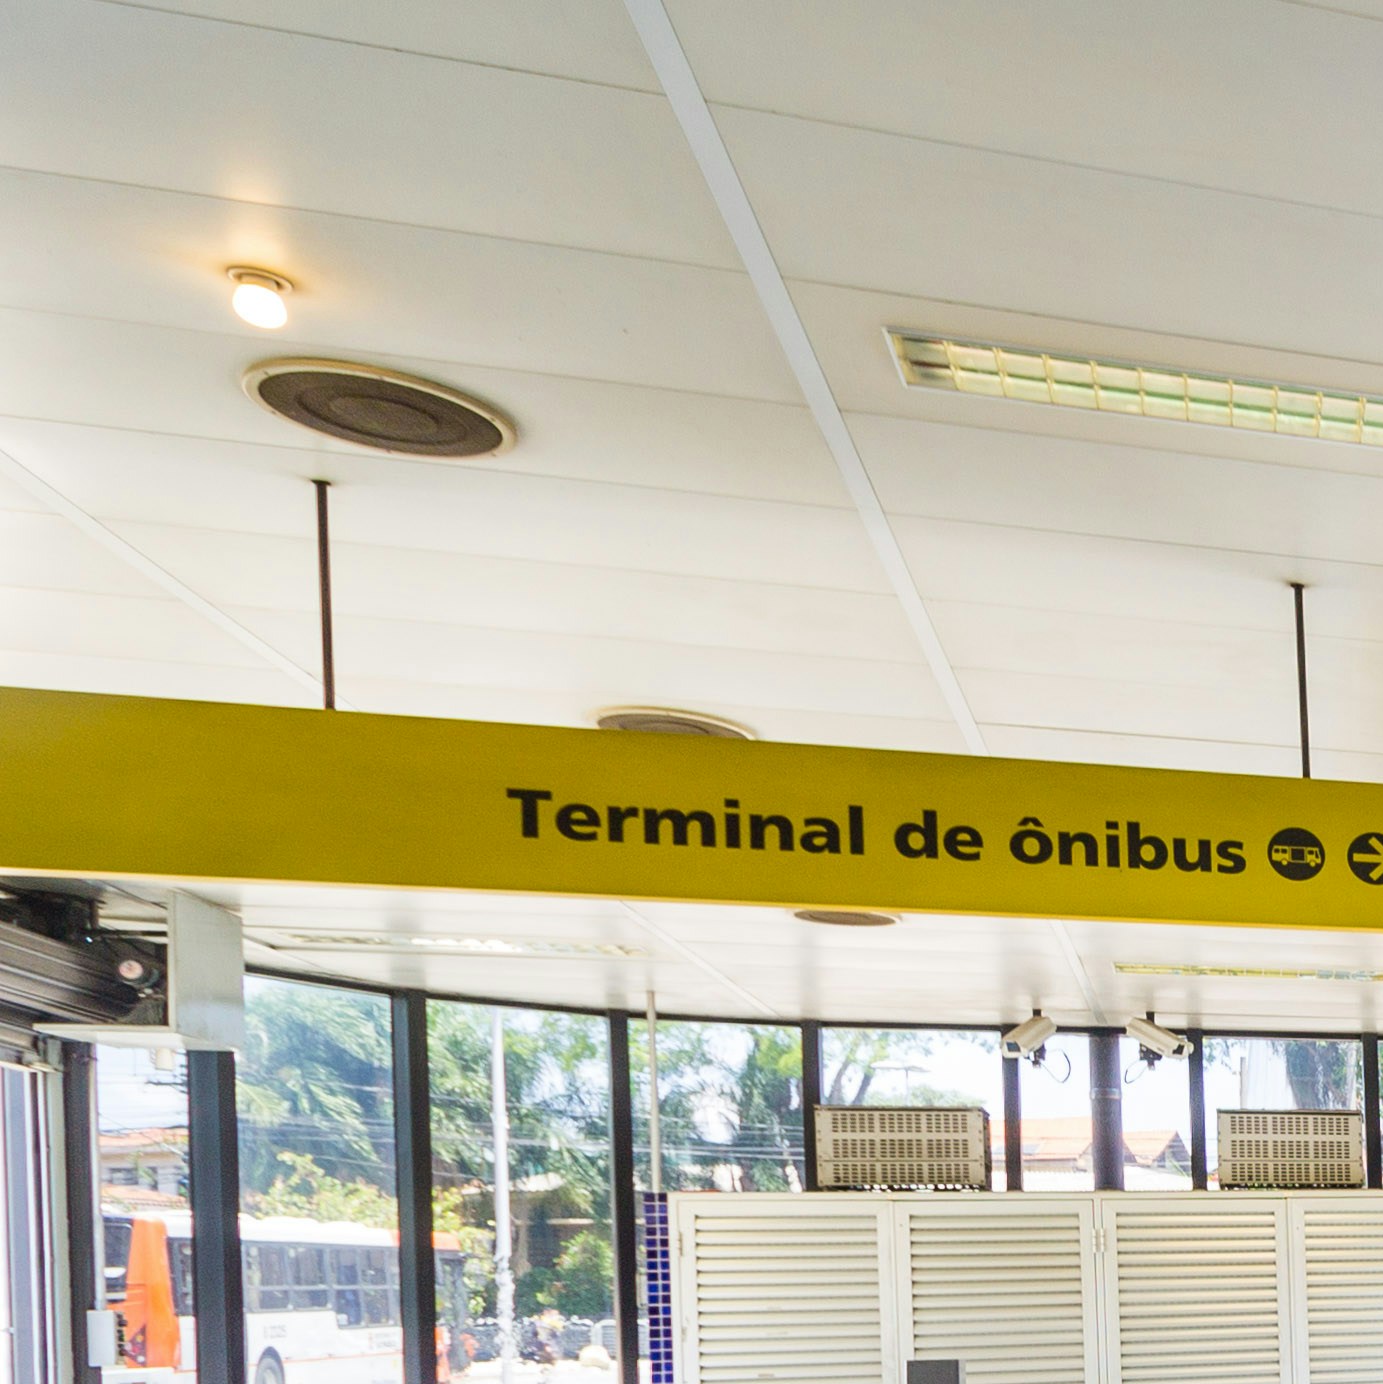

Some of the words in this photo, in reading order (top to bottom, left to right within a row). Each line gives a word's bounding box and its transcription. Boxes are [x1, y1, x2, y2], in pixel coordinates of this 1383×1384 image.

[506, 788, 864, 856] Terminal
[893, 810, 983, 862] de
[1009, 817, 1247, 875] ônibus
